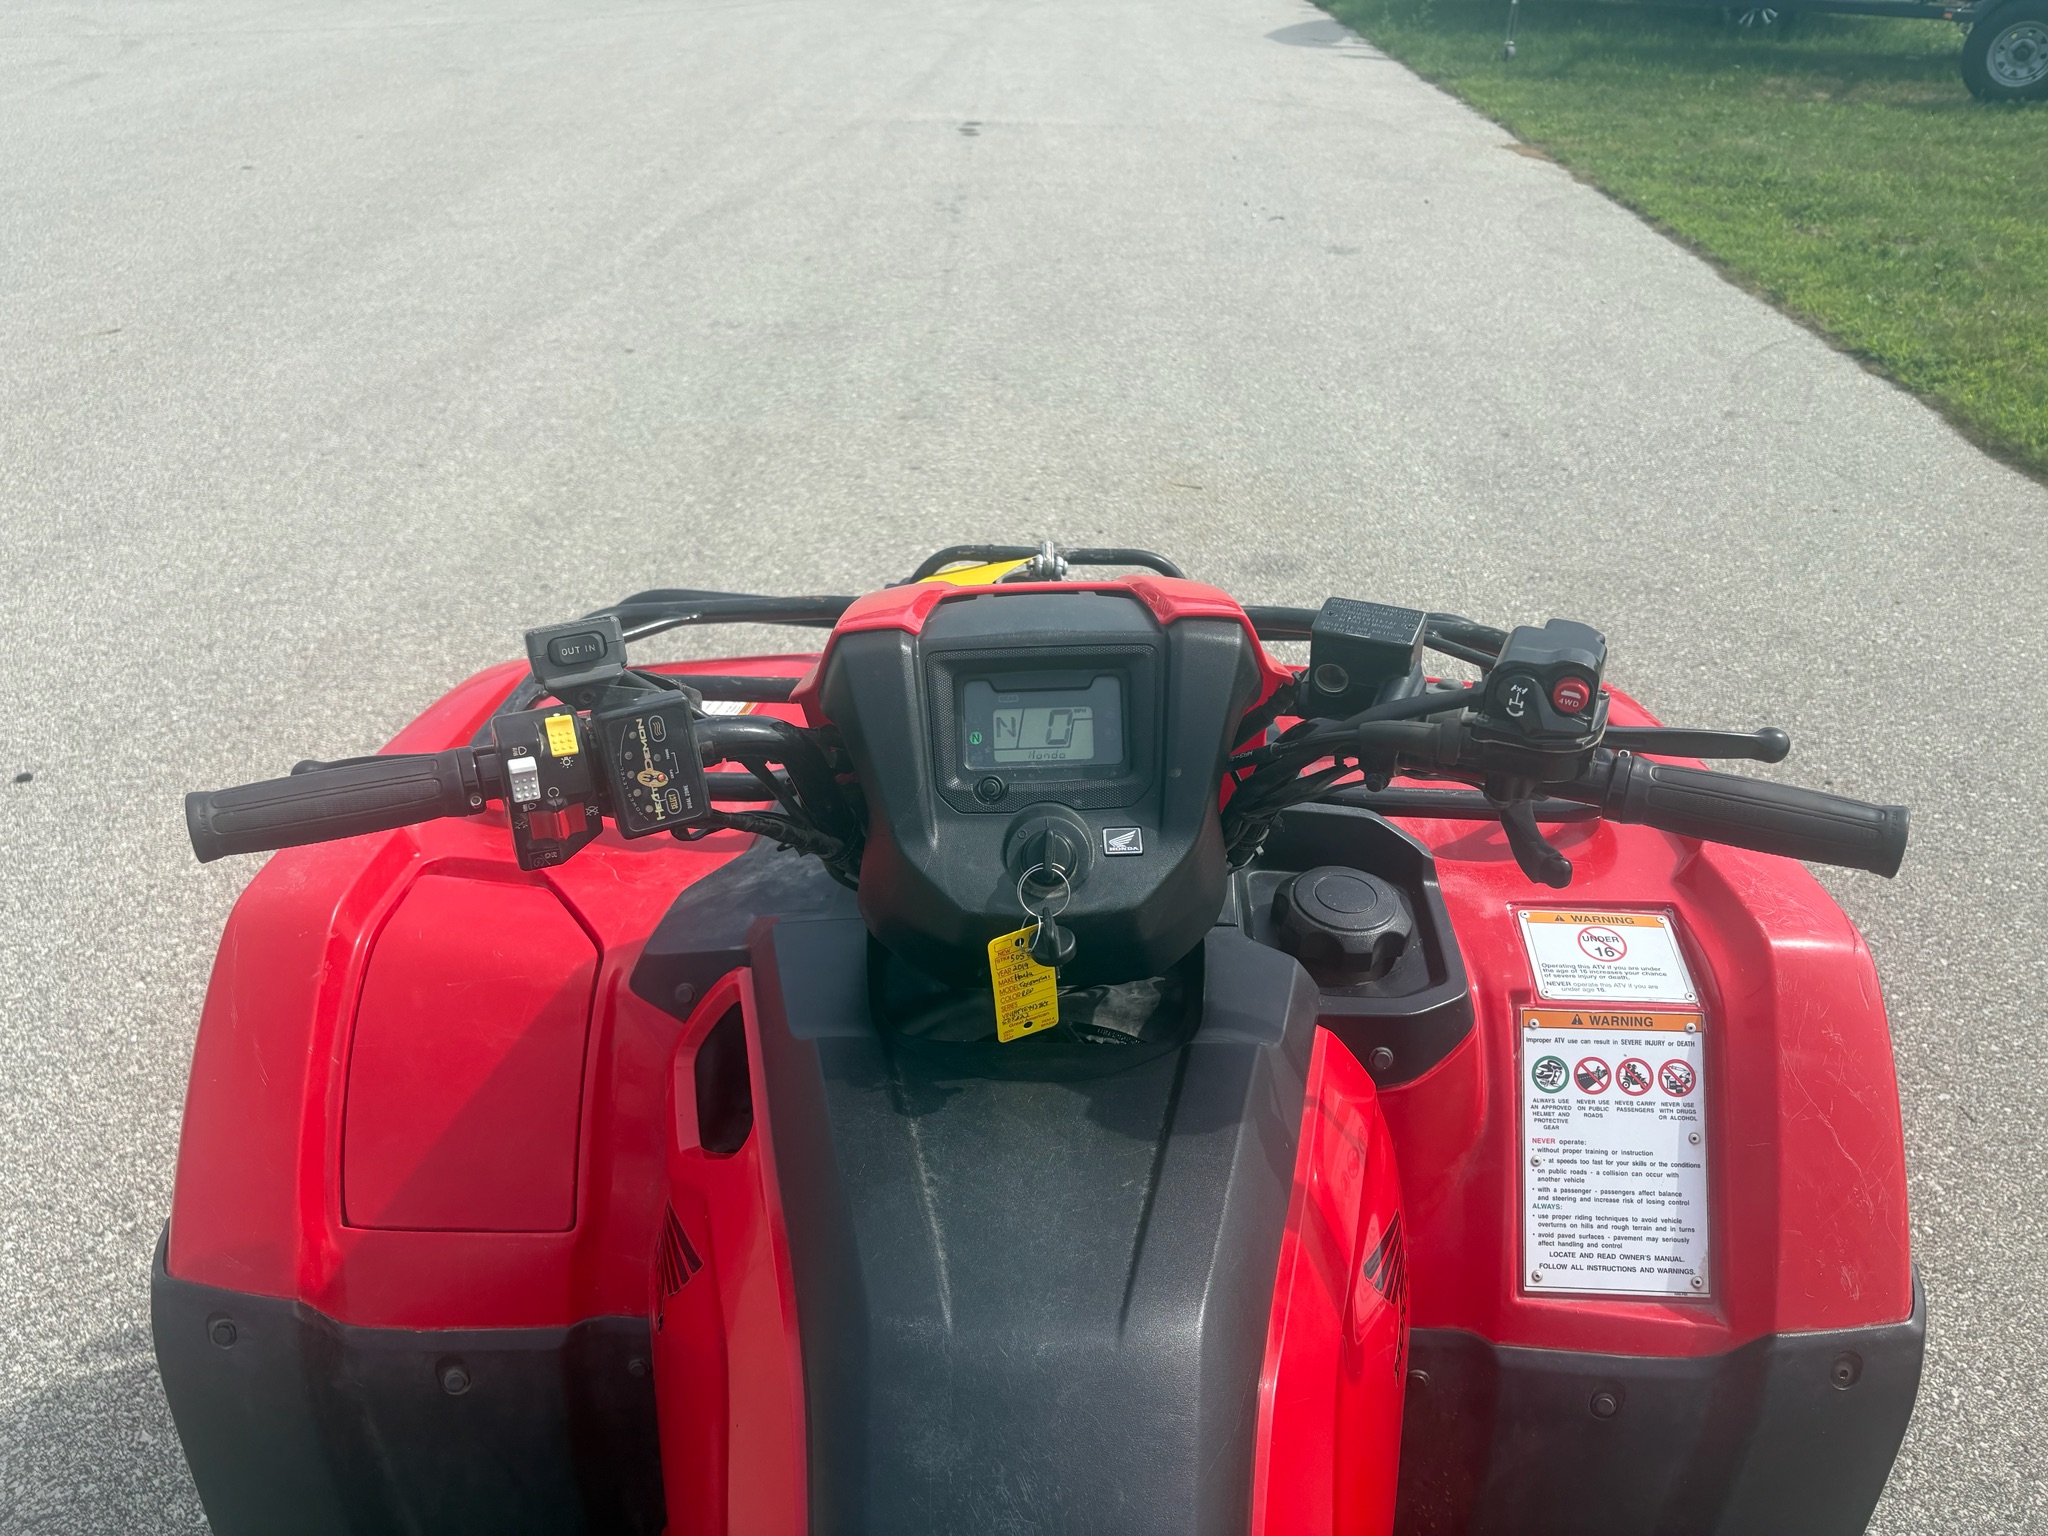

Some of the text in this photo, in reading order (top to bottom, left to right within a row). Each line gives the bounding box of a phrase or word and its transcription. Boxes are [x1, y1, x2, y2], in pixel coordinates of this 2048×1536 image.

[561, 644, 596, 656] OUT IN
[1559, 698, 1579, 708] 4WD
[996, 716, 1016, 738] N
[1028, 750, 1066, 760] Honda
[620, 766, 643, 816] POWER LEVEL
[668, 794, 678, 810] SELECT
[1570, 916, 1634, 924] WARNING
[1595, 946, 1615, 957] 16
[997, 962, 1029, 978] YEAR 2019
[998, 976, 1014, 986] MAKE
[1000, 984, 1019, 995] MODEL
[1000, 992, 1021, 1004] COLOR
[1589, 1016, 1653, 1026] WARNING
